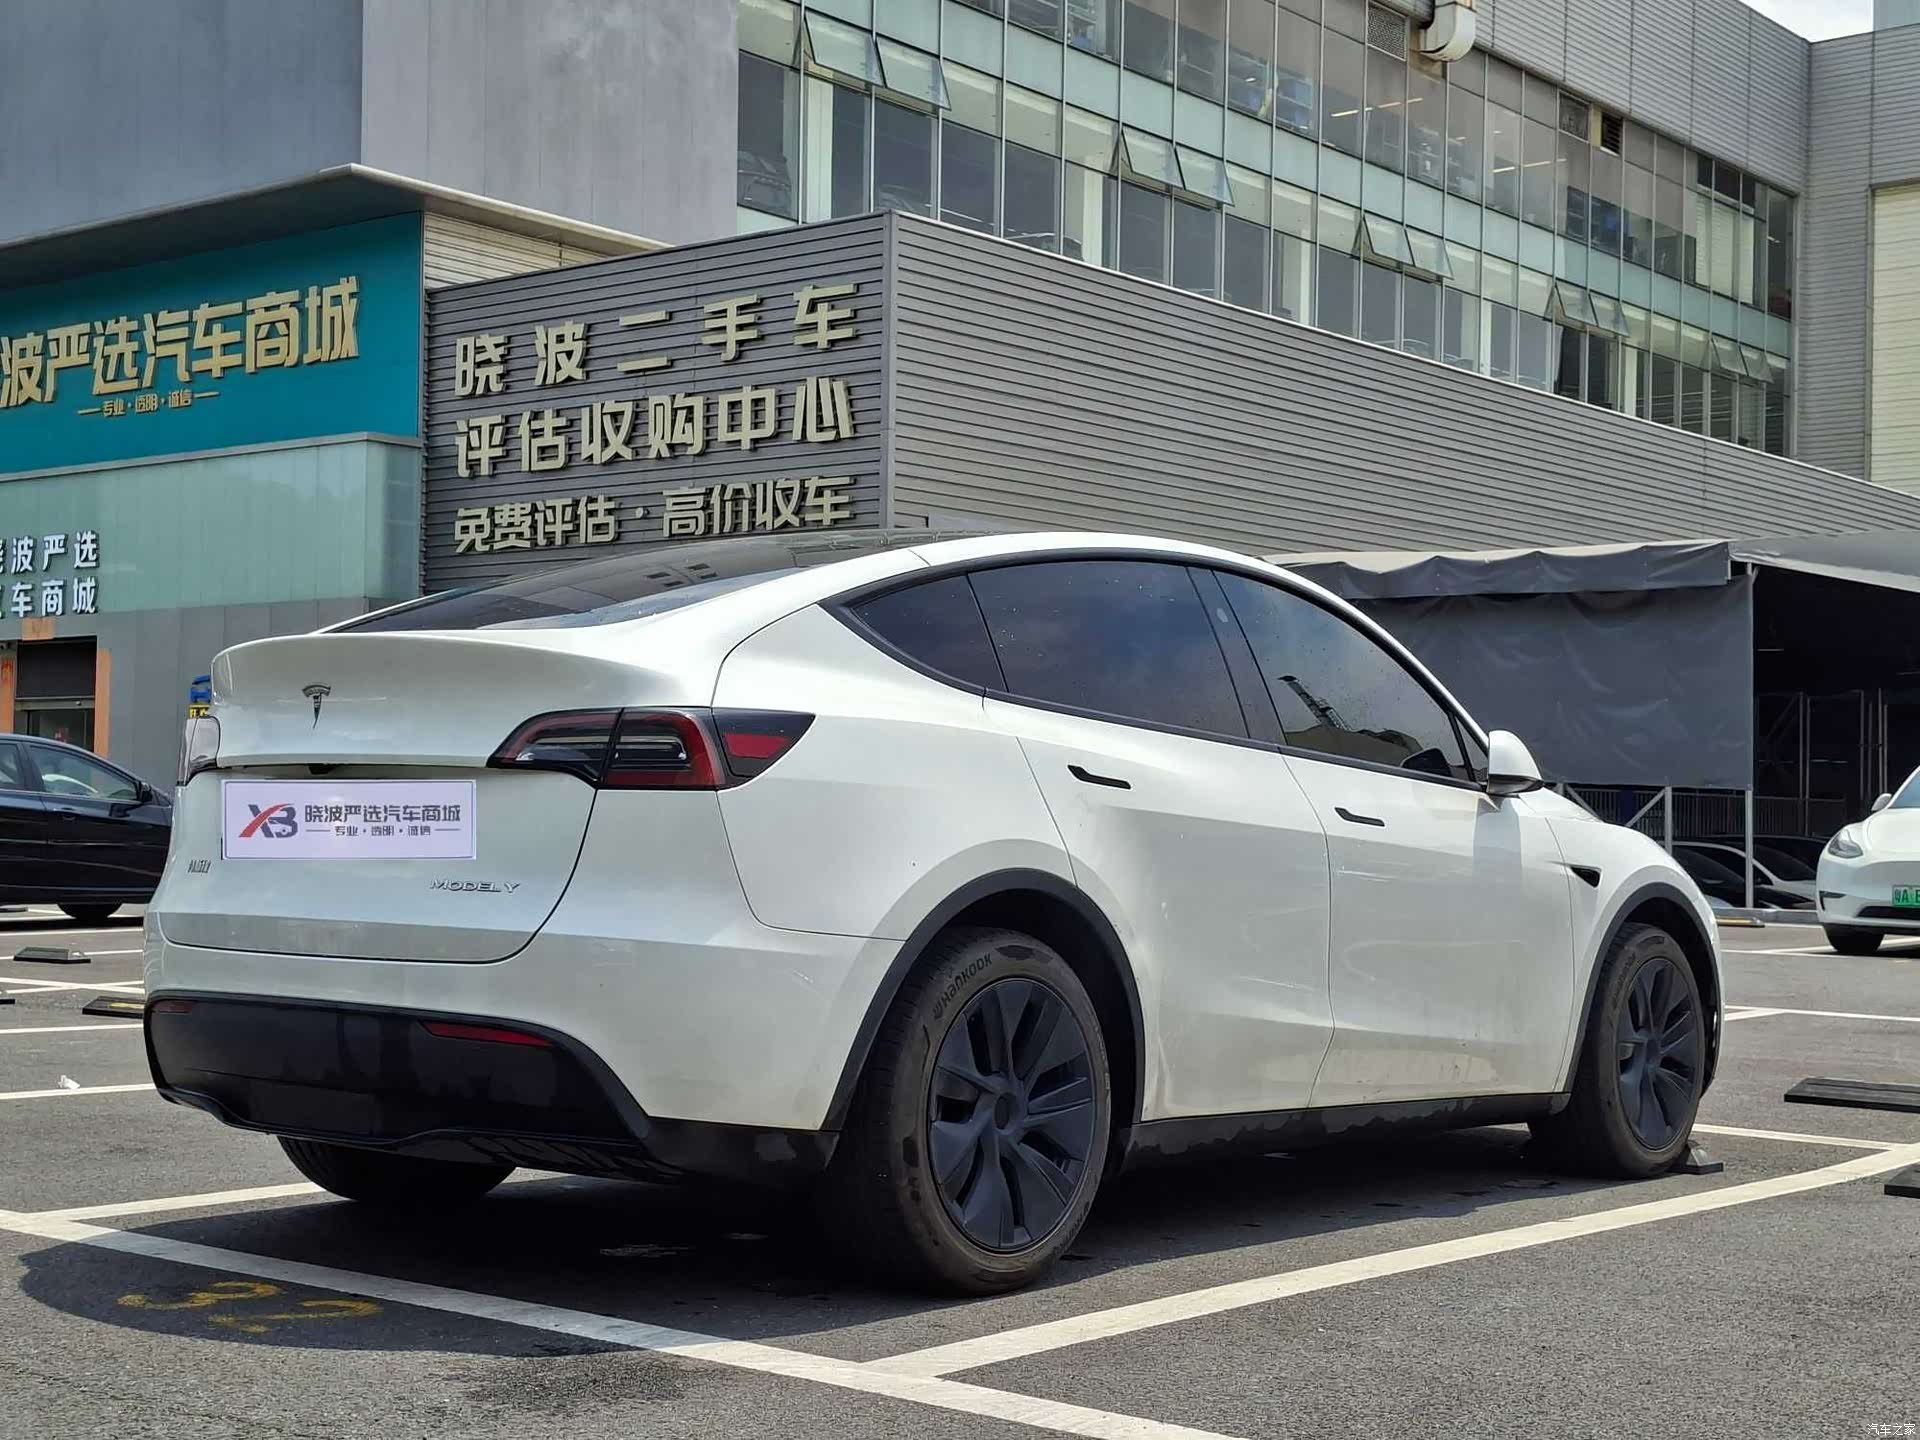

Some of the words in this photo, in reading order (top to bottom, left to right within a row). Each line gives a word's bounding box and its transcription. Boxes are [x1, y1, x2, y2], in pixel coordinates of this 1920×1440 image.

[0, 275, 359, 408] 波严选汽车商城
[454, 283, 859, 397] 晓波二手车
[455, 376, 855, 478] 评估收购中心
[0, 530, 97, 574] 波严选
[0, 576, 97, 618] 车商城
[304, 804, 461, 823] 晓波严选汽车商城
[430, 879, 501, 893] MODEL
[504, 882, 520, 893] Y
